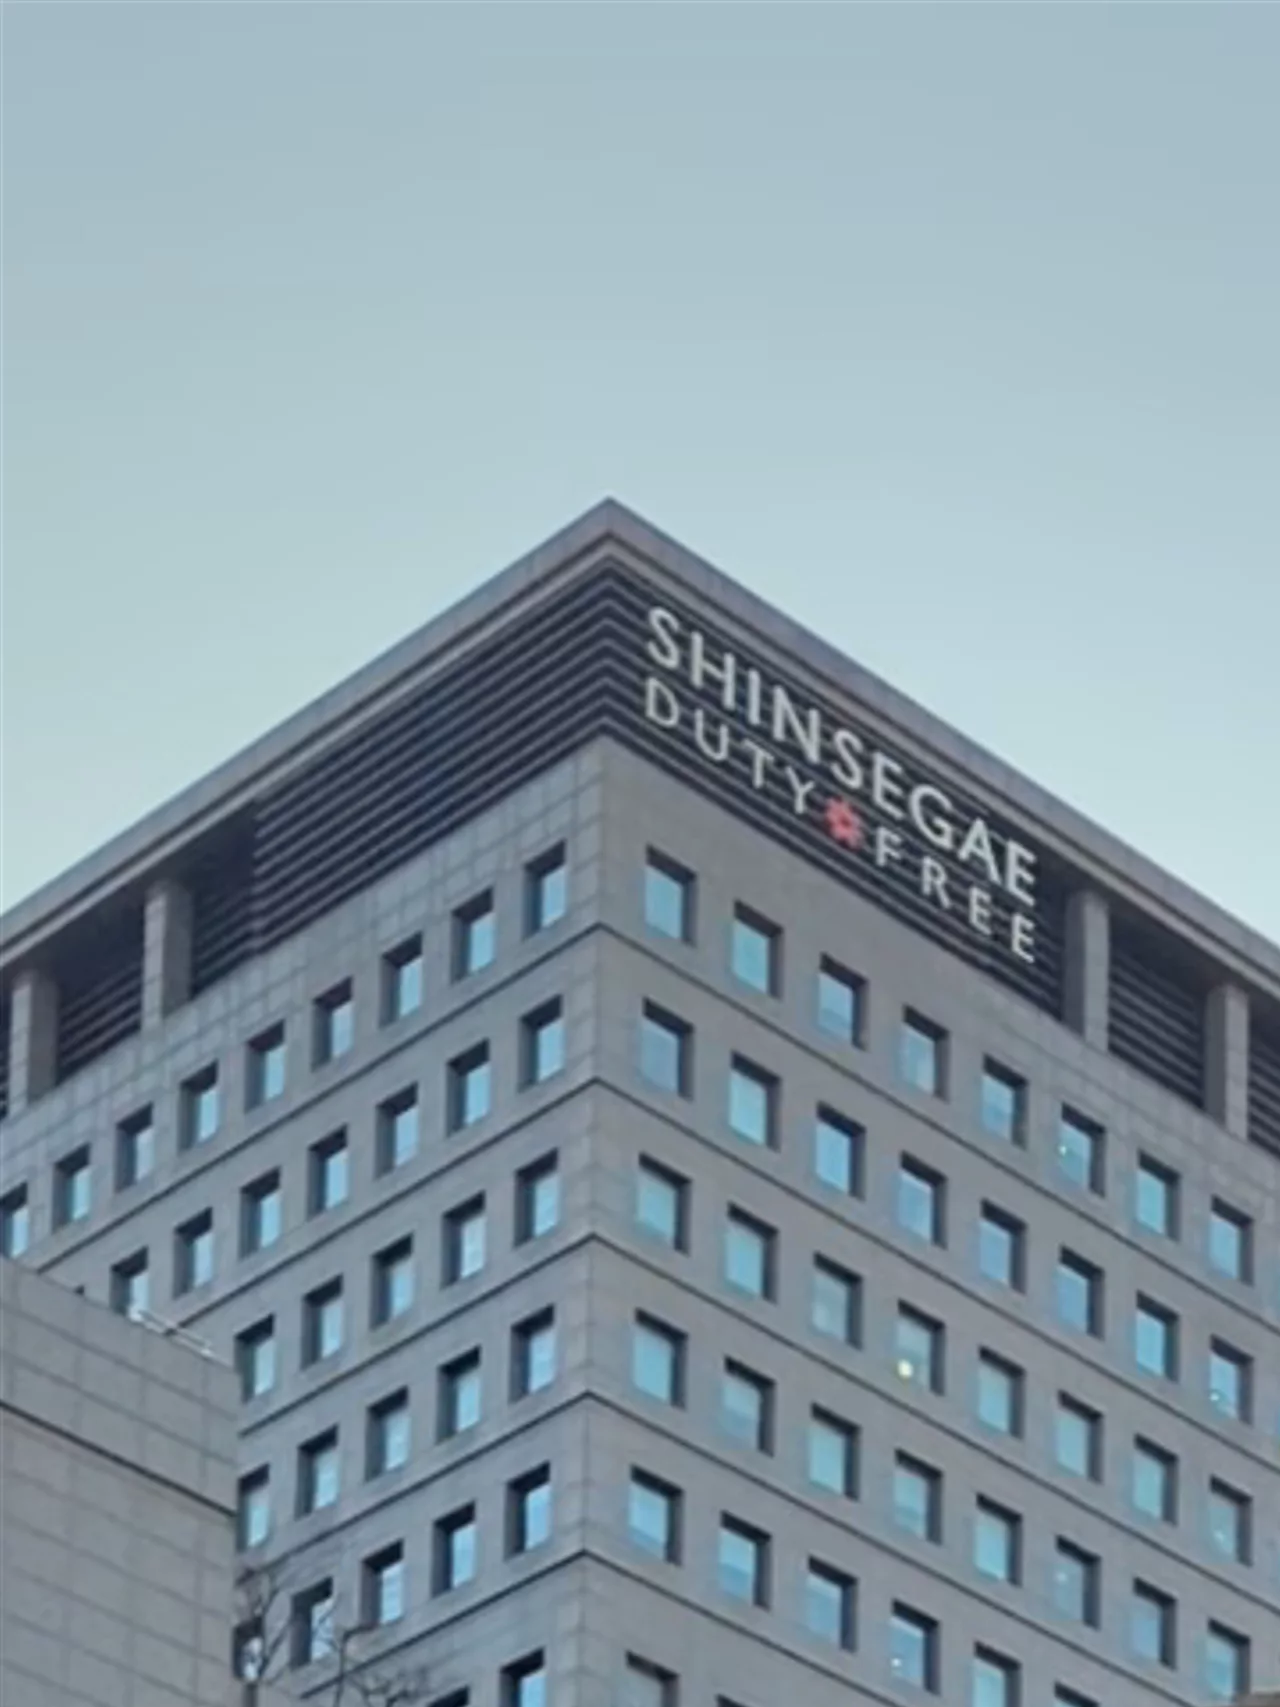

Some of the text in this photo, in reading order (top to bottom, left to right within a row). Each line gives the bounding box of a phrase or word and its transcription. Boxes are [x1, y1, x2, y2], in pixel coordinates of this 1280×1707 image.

[645, 677, 1036, 962] DUTY FREE
[647, 606, 1036, 905] SHINSEGAE
